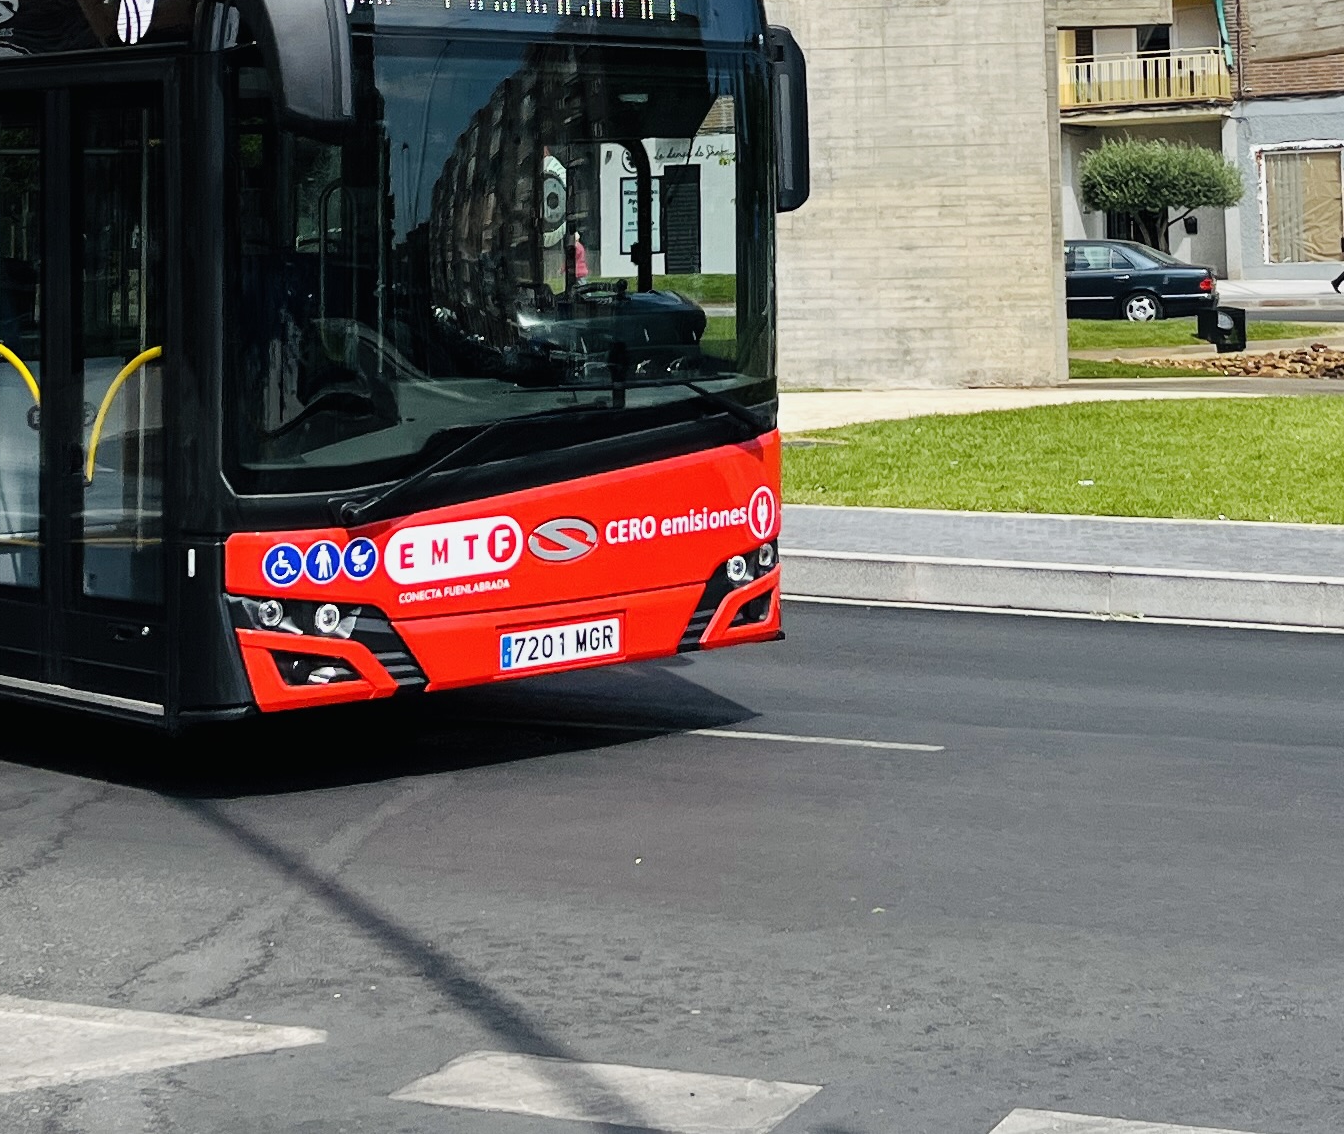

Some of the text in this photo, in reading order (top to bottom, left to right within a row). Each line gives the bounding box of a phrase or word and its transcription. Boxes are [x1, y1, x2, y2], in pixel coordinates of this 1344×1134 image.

[605, 506, 748, 545] CERO emisiones
[399, 525, 514, 570] EMTF
[398, 578, 511, 604] CONECTA FUENLABRADA
[514, 624, 614, 664] 7201 MGR
